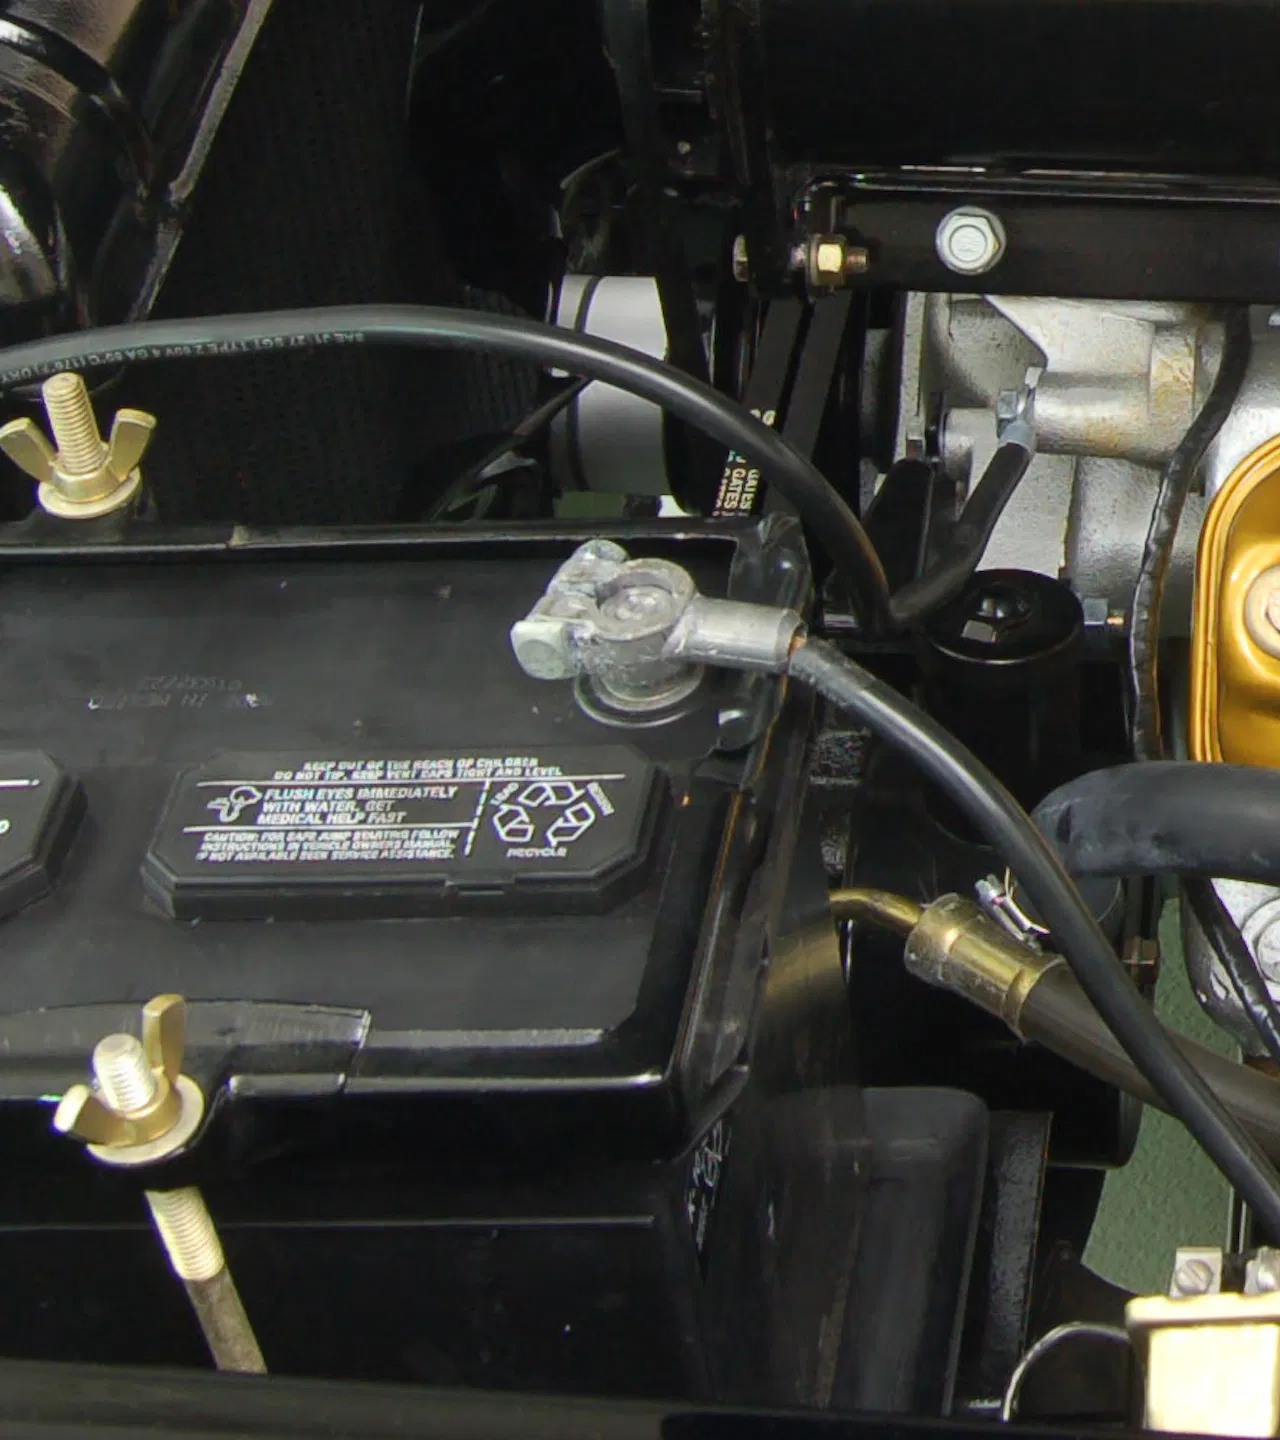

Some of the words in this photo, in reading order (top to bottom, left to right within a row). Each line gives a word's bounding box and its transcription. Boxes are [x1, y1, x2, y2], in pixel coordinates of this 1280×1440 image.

[264, 788, 314, 801] FLUSH
[315, 788, 354, 800] EYES
[356, 786, 459, 800] IMMEDIATELY
[262, 801, 307, 813] WITH
[365, 800, 395, 812] GET
[257, 812, 322, 825] MEDICAL
[326, 812, 365, 824] HELP
[366, 811, 407, 824] FAST
